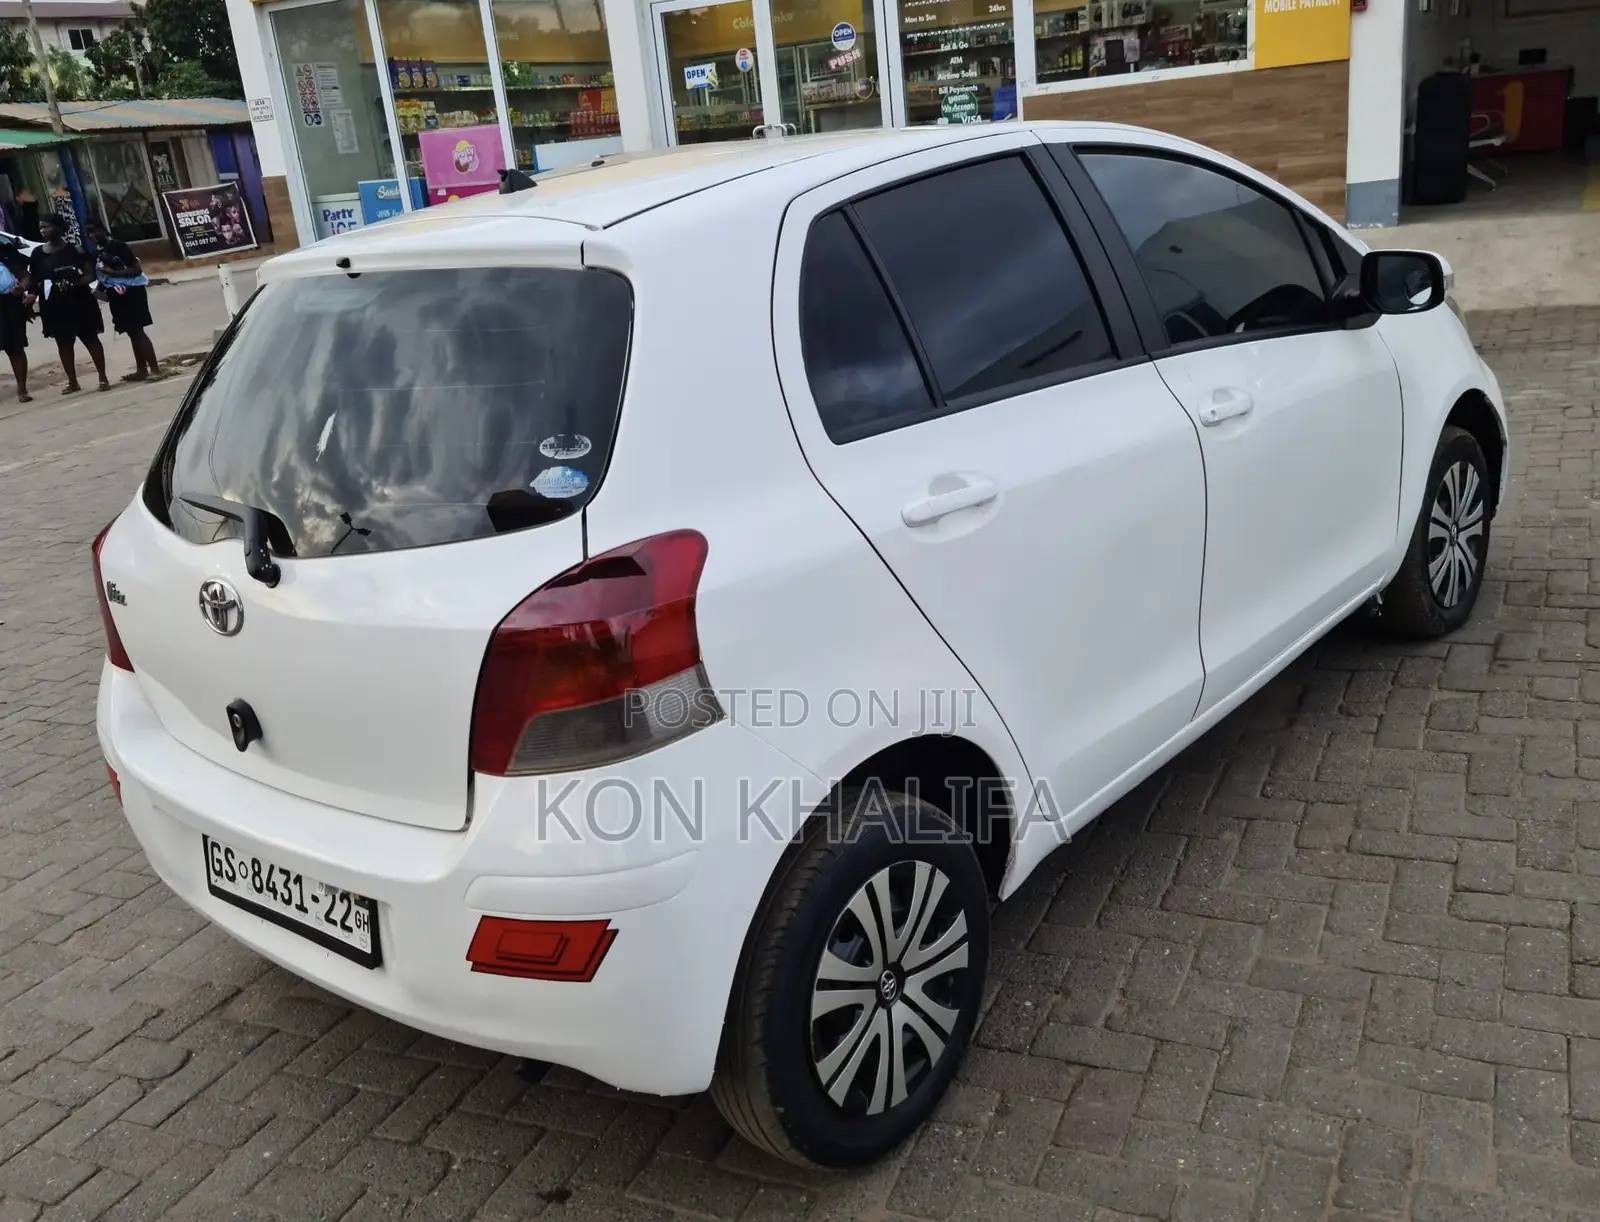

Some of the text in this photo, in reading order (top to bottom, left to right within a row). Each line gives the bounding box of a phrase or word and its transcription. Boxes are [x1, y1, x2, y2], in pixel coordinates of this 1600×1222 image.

[988, 4, 1006, 13] 24hrs
[1264, 0, 1297, 14] MOBILE
[904, 16, 918, 24] Mon
[834, 27, 852, 37] OPEN
[952, 41, 958, 50] &
[959, 41, 969, 49] Go
[829, 48, 861, 70] PUSH
[950, 56, 963, 65] ATM
[686, 69, 706, 80] OPEN
[937, 72, 960, 81] Airtime
[938, 84, 978, 95] Bill Payments
[960, 115, 982, 124] VISA
[322, 208, 354, 222] Party
[210, 841, 354, 934] GS 8431-22
[354, 910, 370, 934] GH
